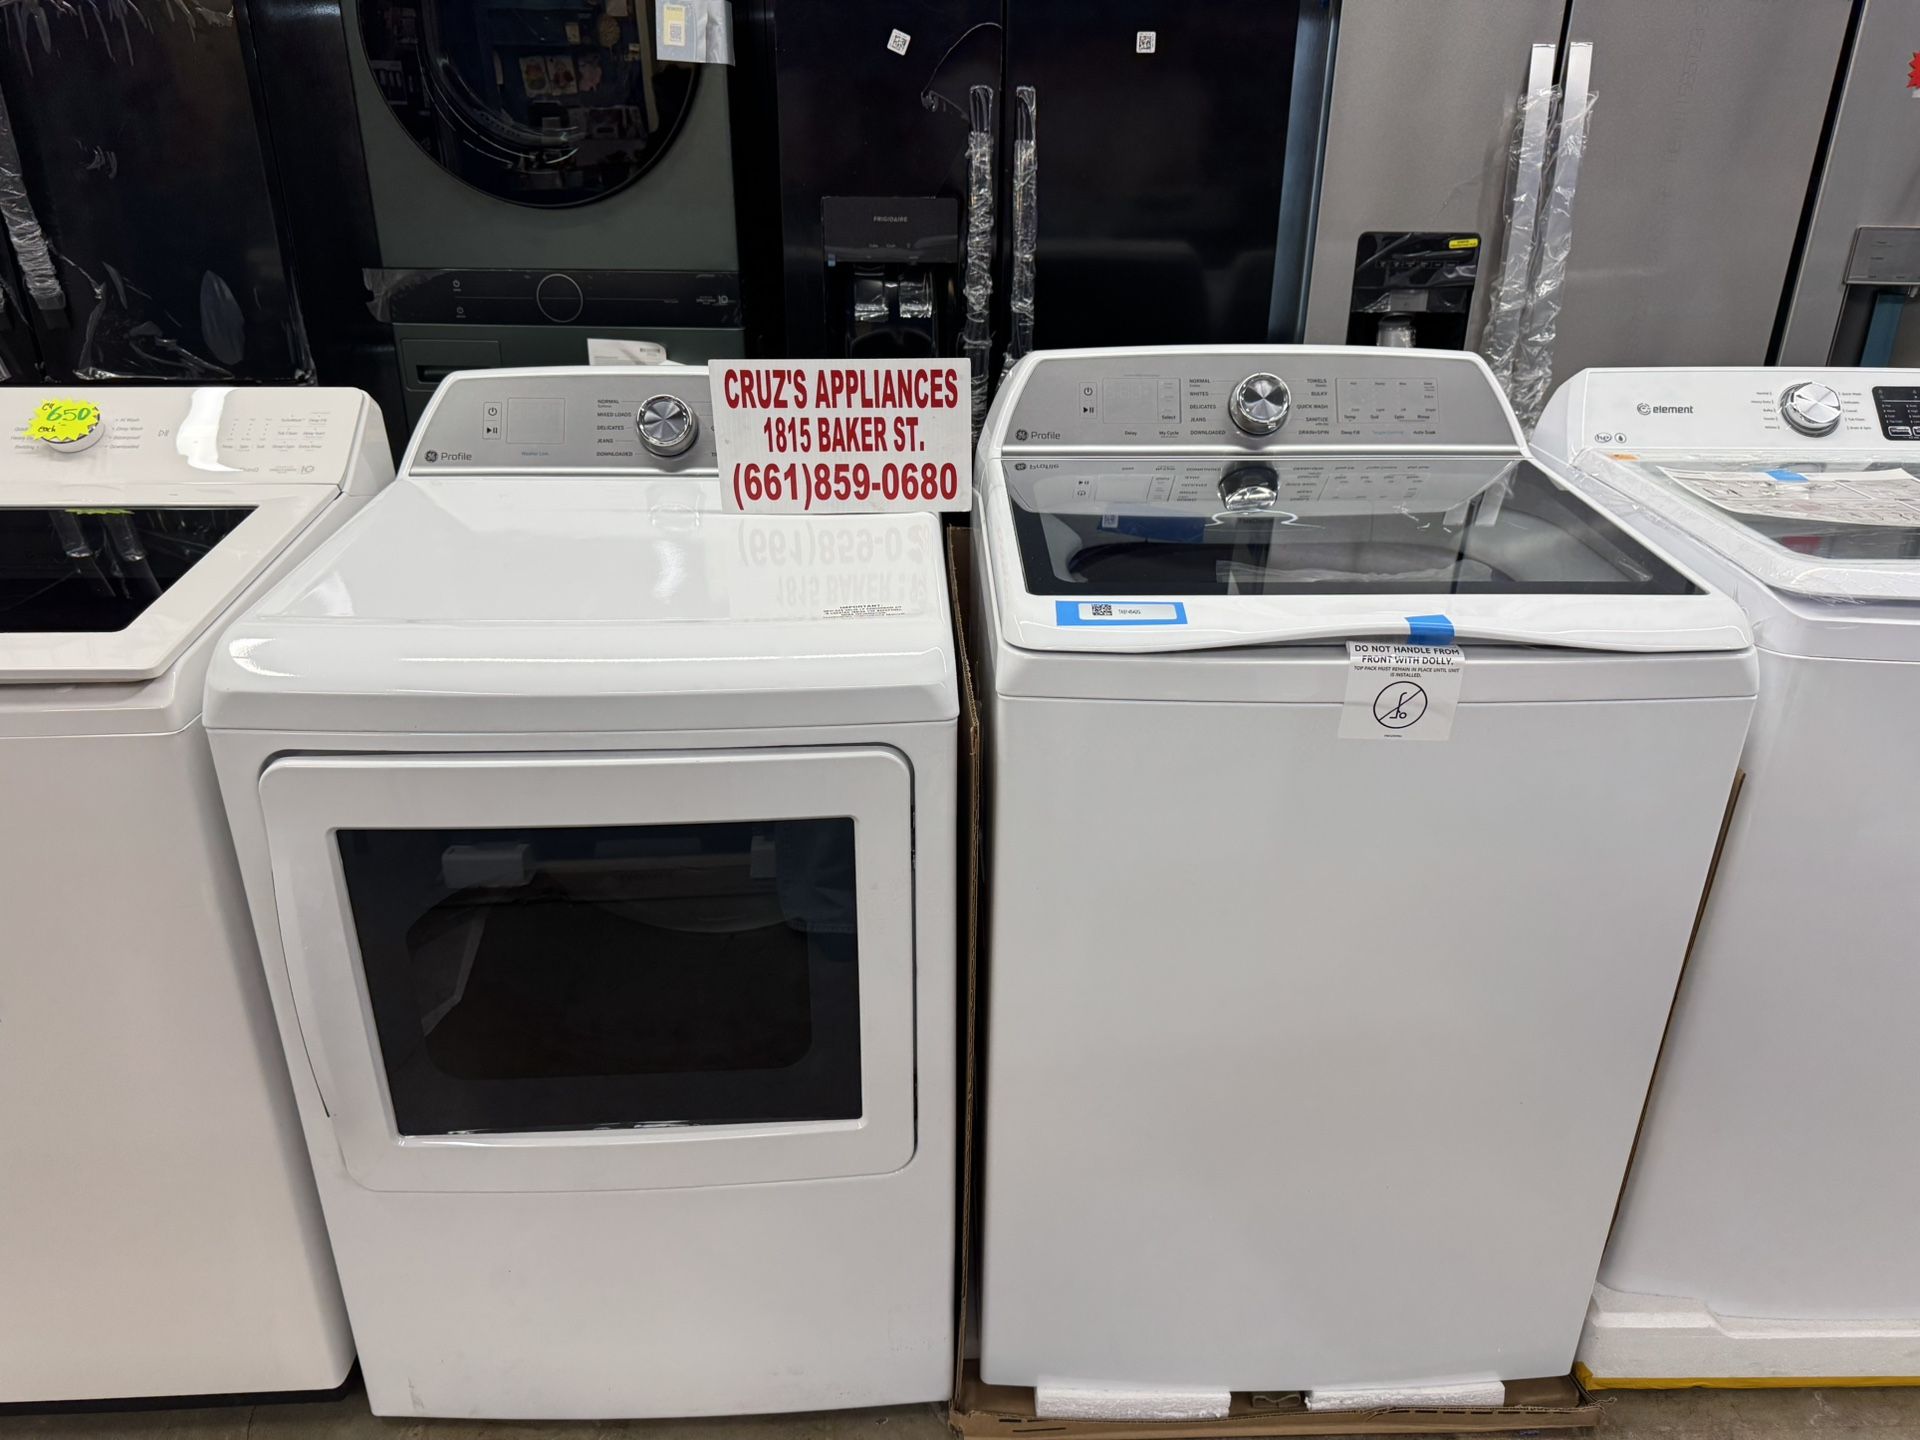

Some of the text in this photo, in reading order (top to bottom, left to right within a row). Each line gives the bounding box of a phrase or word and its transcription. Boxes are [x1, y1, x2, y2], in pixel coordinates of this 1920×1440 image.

[724, 368, 959, 409] CRUZ'S APPLIANCES
[47, 405, 91, 421] 650
[1652, 405, 1694, 414] element
[763, 416, 925, 452] 1815 BAKER ST.
[1030, 431, 1061, 440] Profile
[441, 452, 472, 461] Profile
[733, 462, 958, 511] (661)859-0680
[1354, 644, 1460, 655] DO NOT HANDLE FROM
[1361, 654, 1454, 665] FRONT WITH DOLLY.
